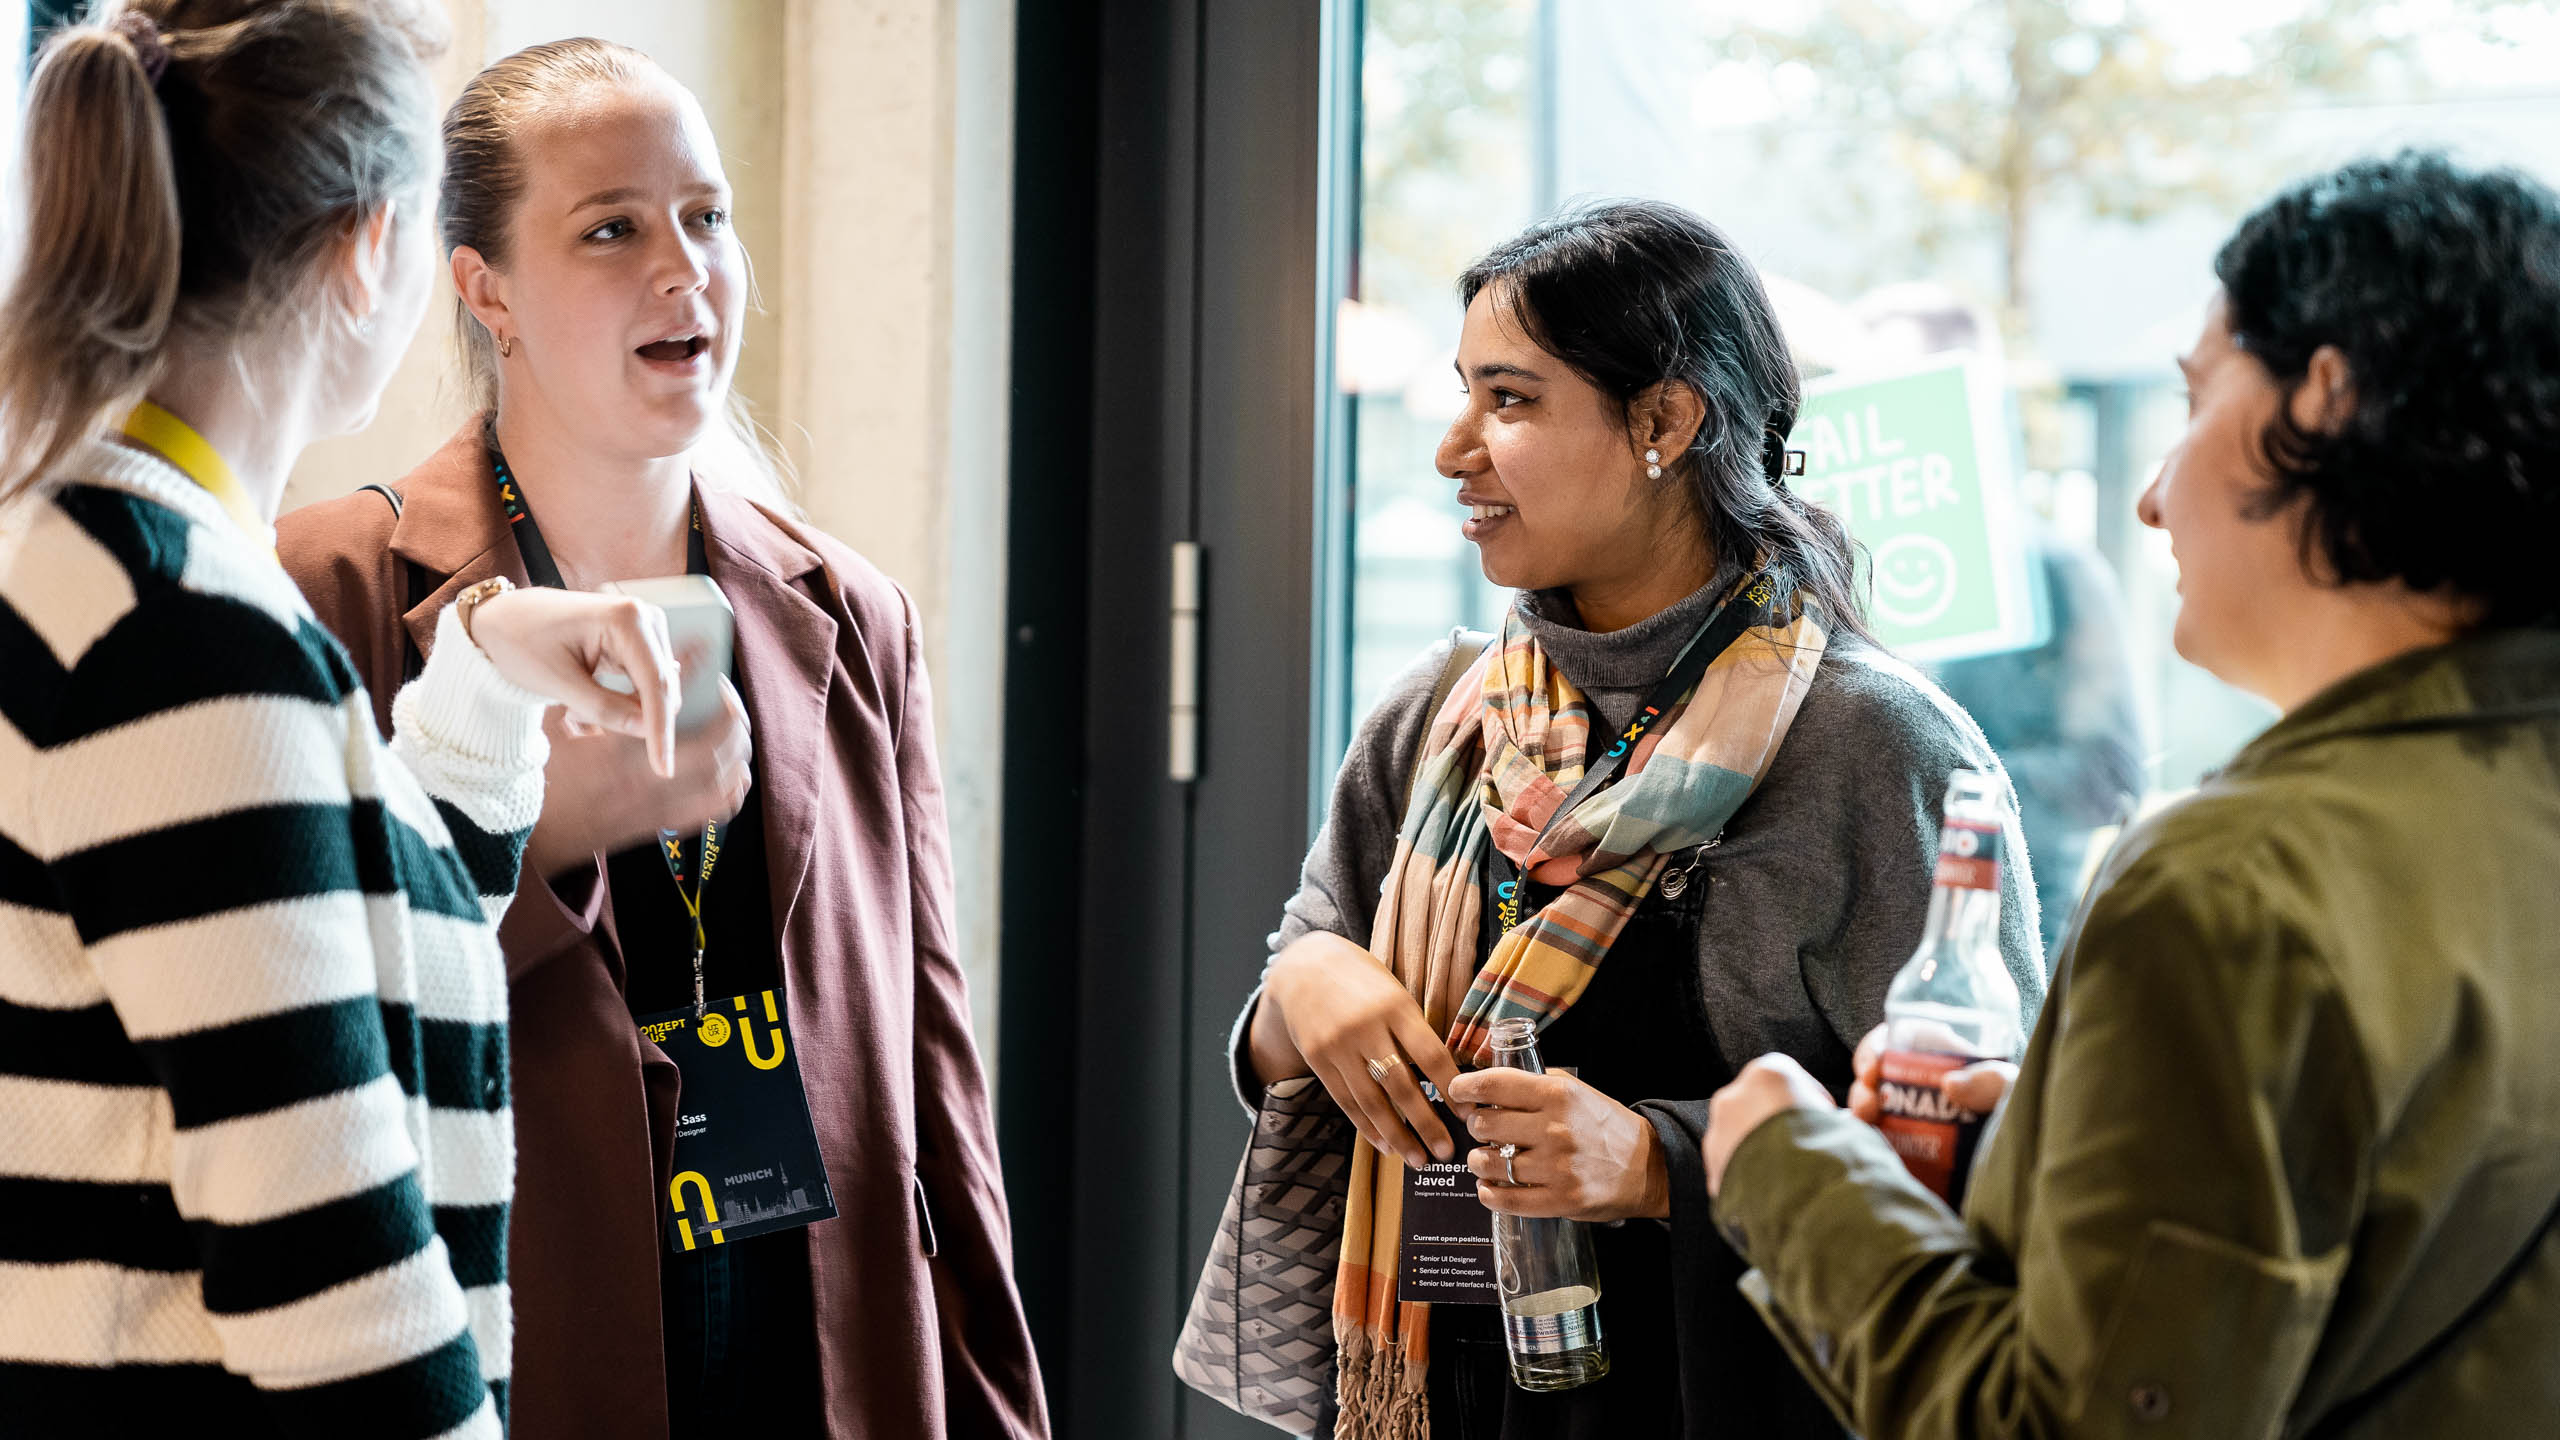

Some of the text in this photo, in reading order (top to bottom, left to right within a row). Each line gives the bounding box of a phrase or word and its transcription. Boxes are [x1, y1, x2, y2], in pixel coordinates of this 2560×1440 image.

[1800, 453, 1960, 524] ETTER
[681, 1113, 707, 1125] Sass
[678, 1127, 706, 1138] Designer
[724, 1168, 773, 1186] MUNICH
[1414, 1174, 1455, 1187] Javed
[1414, 1190, 1435, 1198] Designer
[1413, 1234, 1439, 1242] Current
[1458, 1235, 1490, 1243] positions
[1449, 1256, 1477, 1264] Designer
[1419, 1267, 1439, 1275] Senior
[1450, 1268, 1485, 1277] Concepter
[1418, 1279, 1439, 1287] Senior
